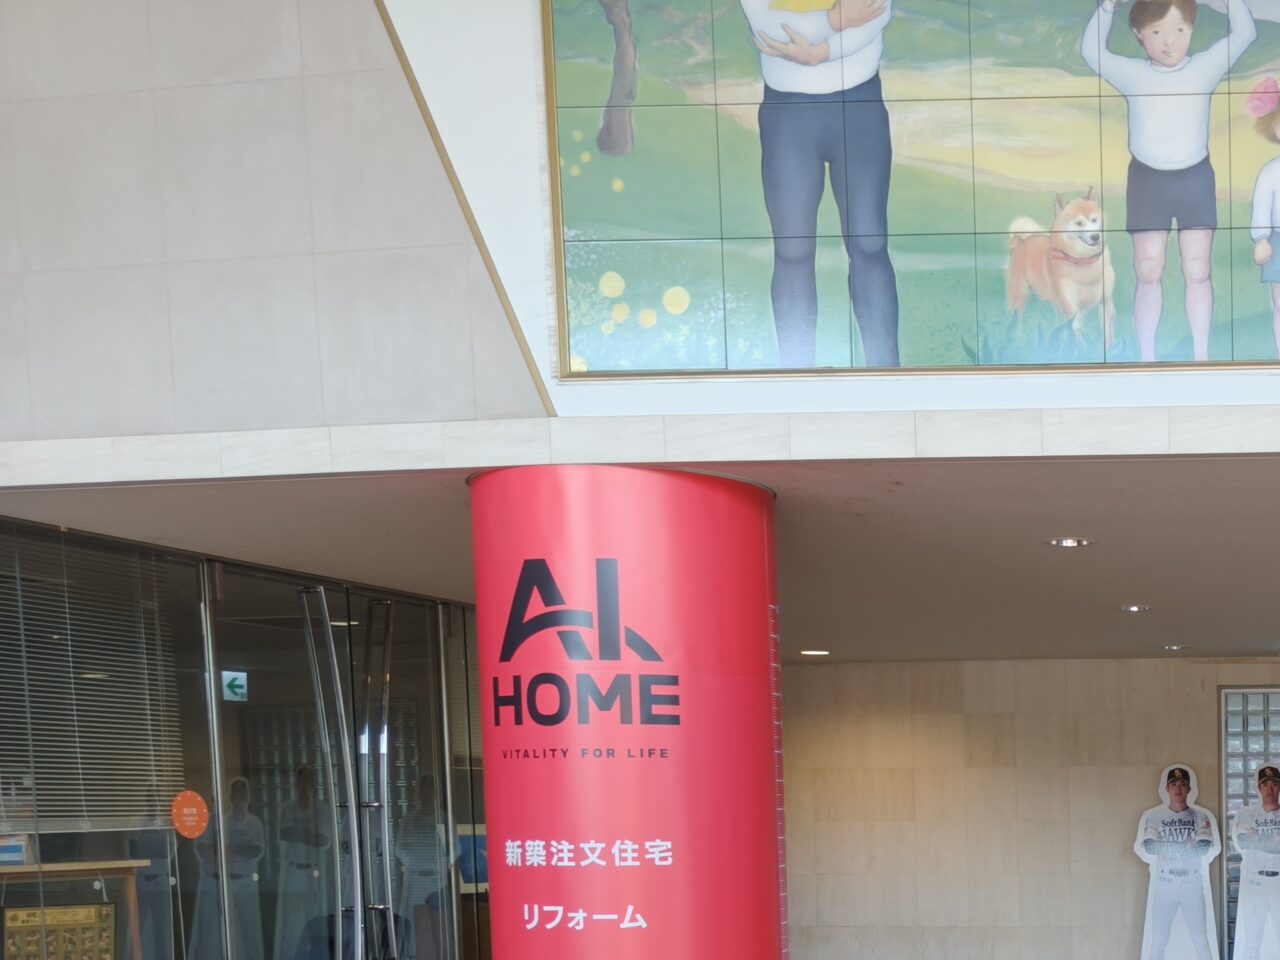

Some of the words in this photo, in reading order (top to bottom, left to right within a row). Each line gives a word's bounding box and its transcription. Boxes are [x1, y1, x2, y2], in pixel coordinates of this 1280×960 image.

[493, 673, 681, 726] HOME
[502, 748, 568, 759] VITALITY
[581, 748, 615, 758] FOR
[627, 748, 668, 758] LIFE
[1162, 818, 1196, 828] SoftBank
[505, 840, 673, 867] 新築注文住宅
[523, 904, 648, 931] リフォーム
